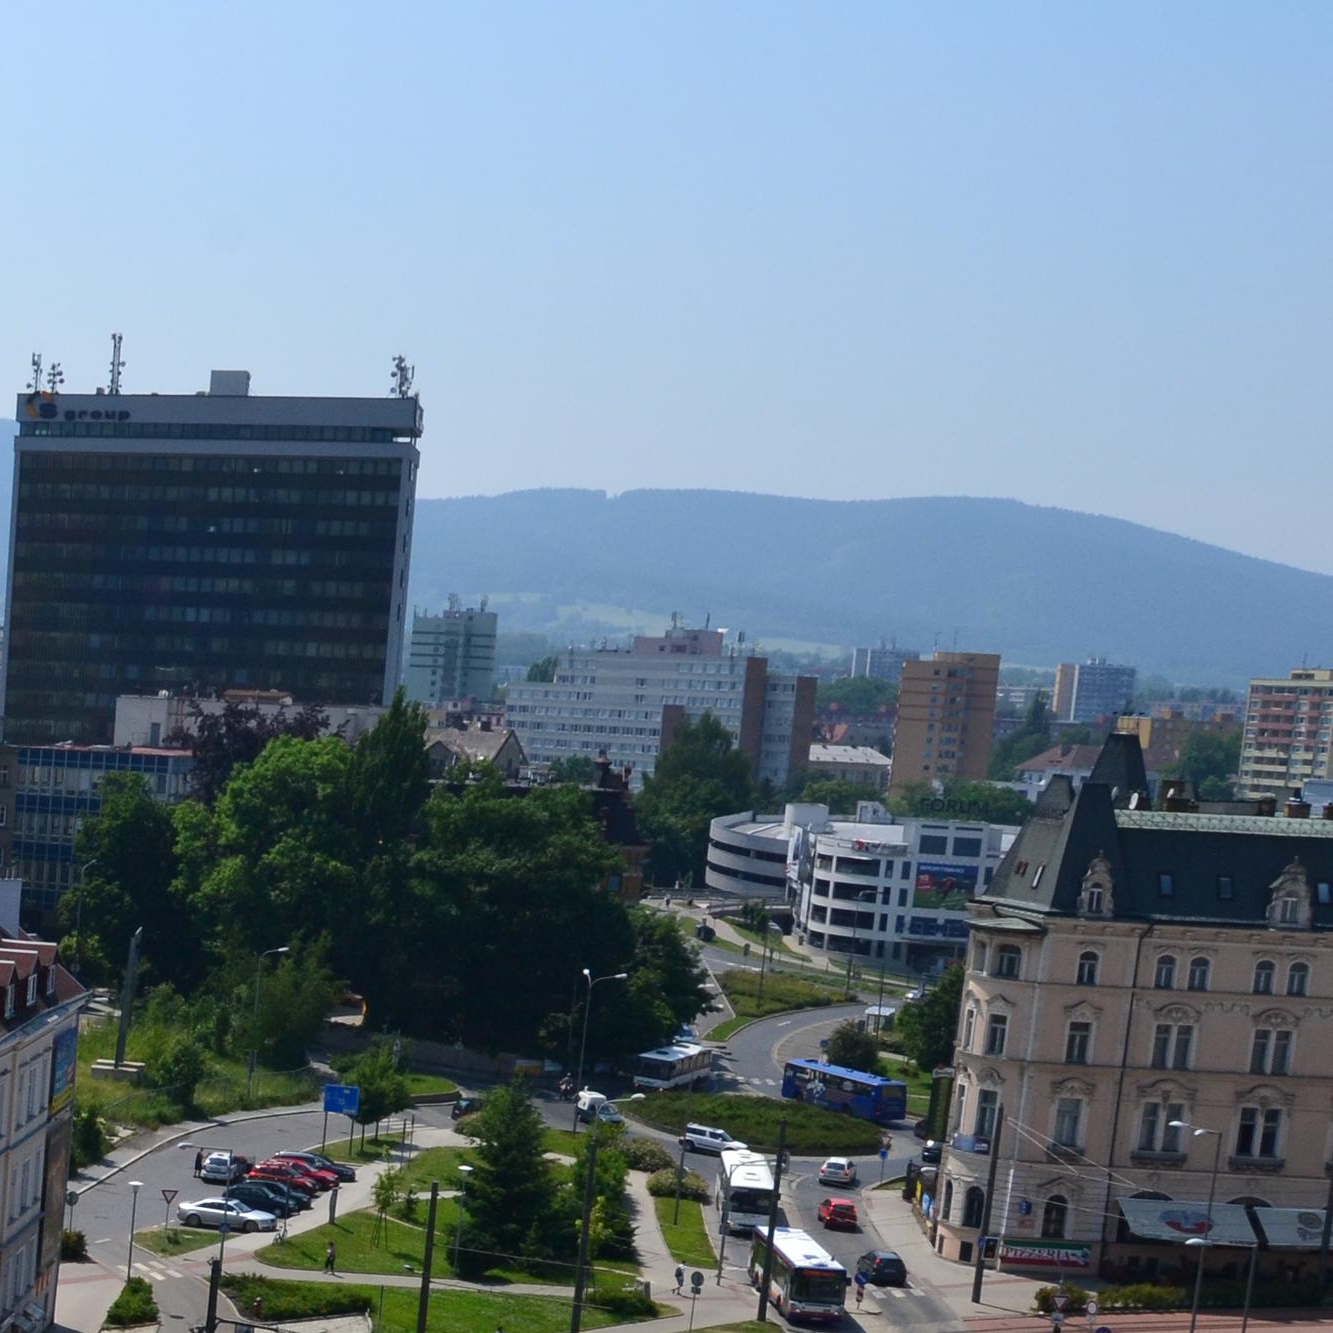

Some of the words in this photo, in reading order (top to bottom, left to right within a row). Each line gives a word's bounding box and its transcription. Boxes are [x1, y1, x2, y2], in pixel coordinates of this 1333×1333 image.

[64, 410, 131, 421] group
[921, 798, 990, 815] FORUM
[1004, 1246, 1070, 1261] PIZZERIA
